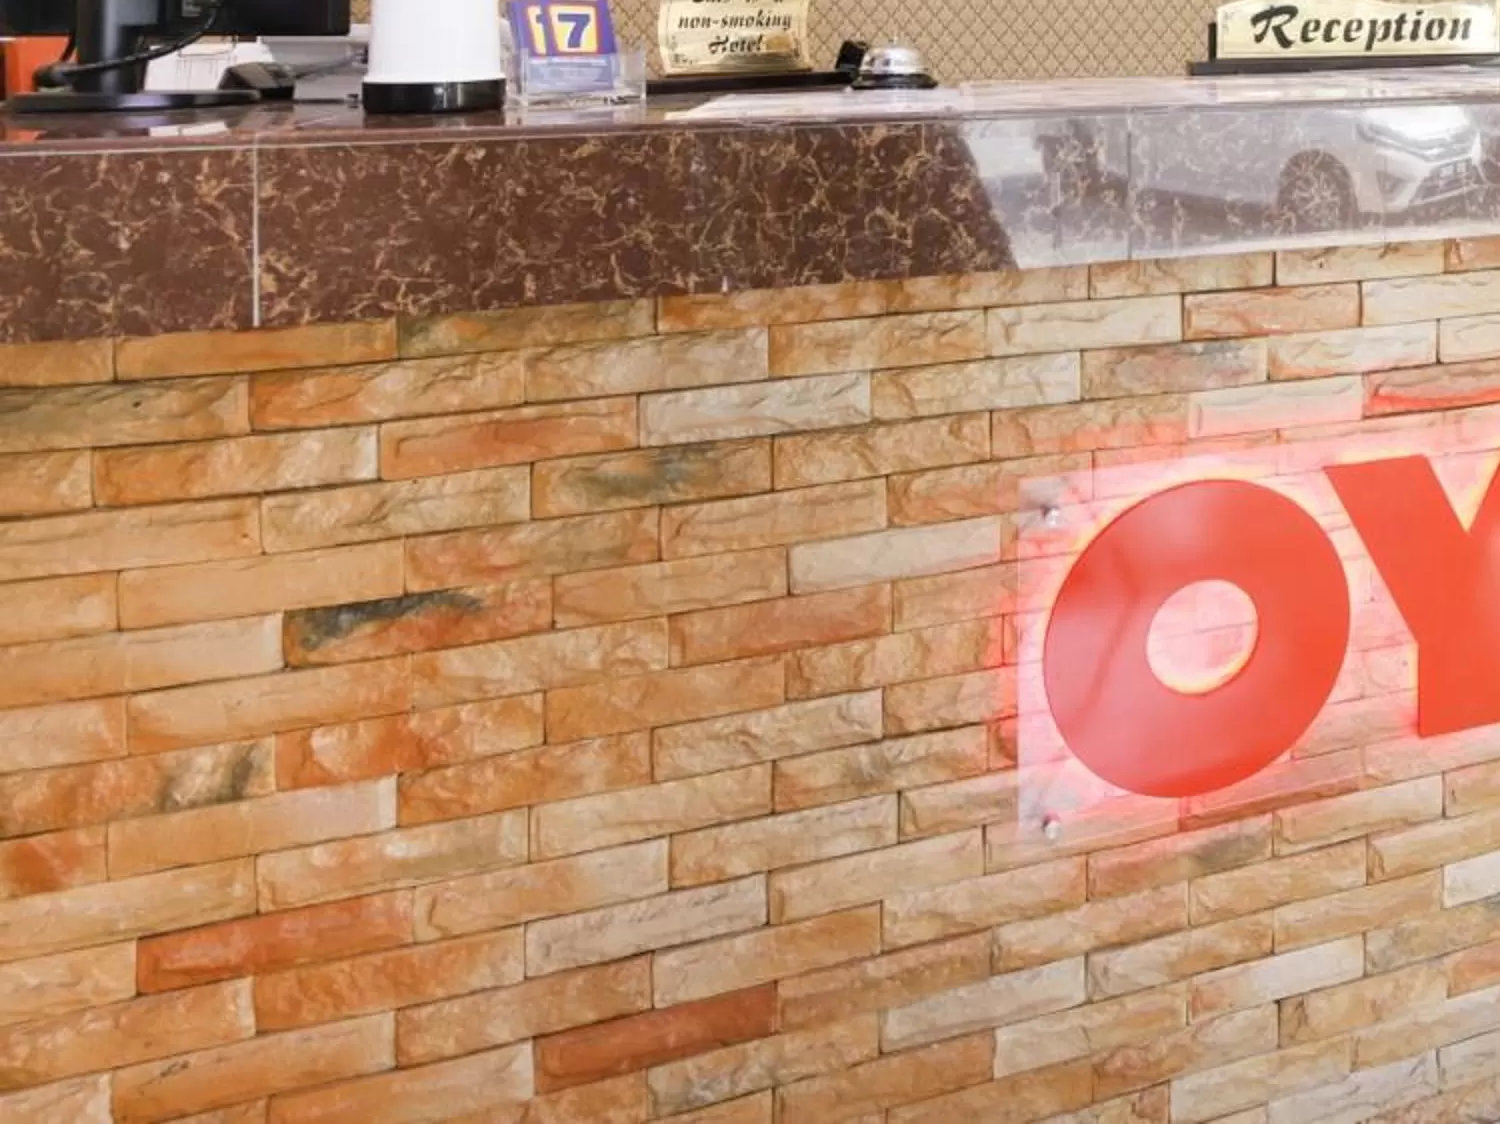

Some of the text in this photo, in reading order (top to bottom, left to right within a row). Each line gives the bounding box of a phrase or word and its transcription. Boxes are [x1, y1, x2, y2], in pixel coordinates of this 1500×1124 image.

[557, 13, 590, 48] 7
[678, 9, 792, 31] non-smoking
[1250, 5, 1472, 52] Reception
[708, 33, 764, 54] Hotel
